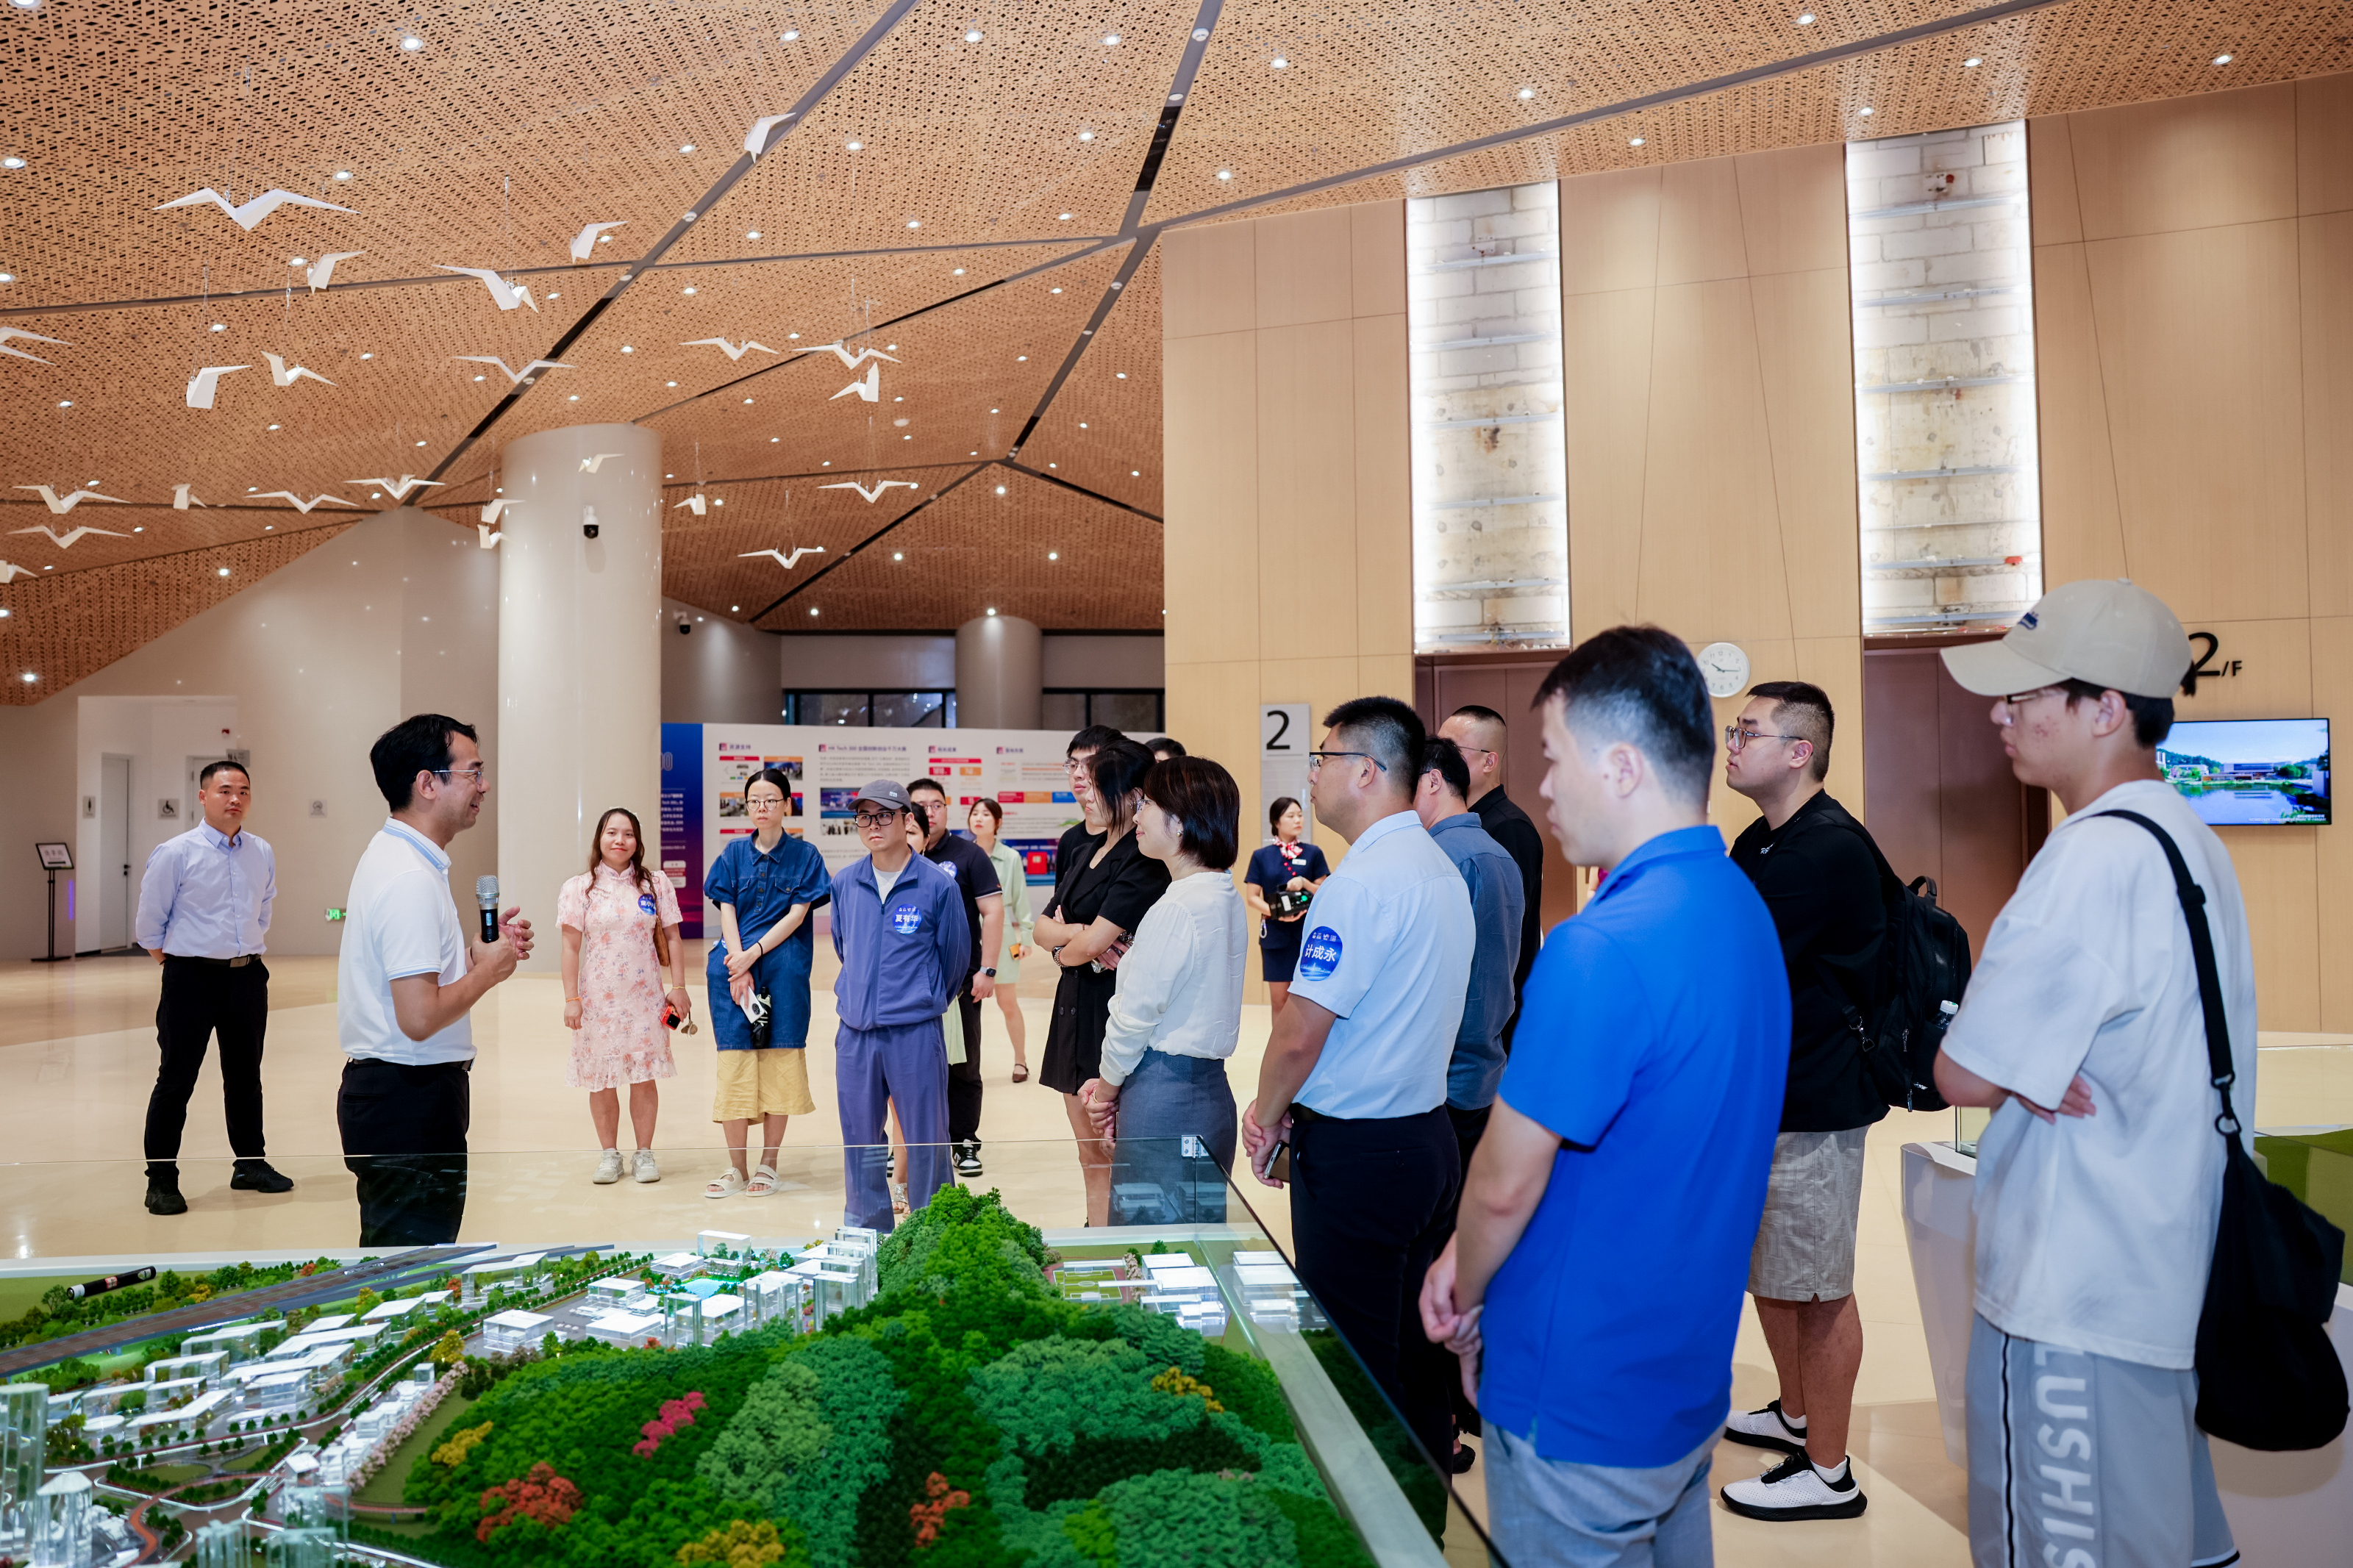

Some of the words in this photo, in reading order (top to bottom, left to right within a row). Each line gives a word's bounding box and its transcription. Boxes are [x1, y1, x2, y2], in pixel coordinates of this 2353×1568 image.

[1266, 710, 1290, 751] 2
[895, 914, 918, 923] 夏有华
[1304, 944, 1337, 962] 计成永
